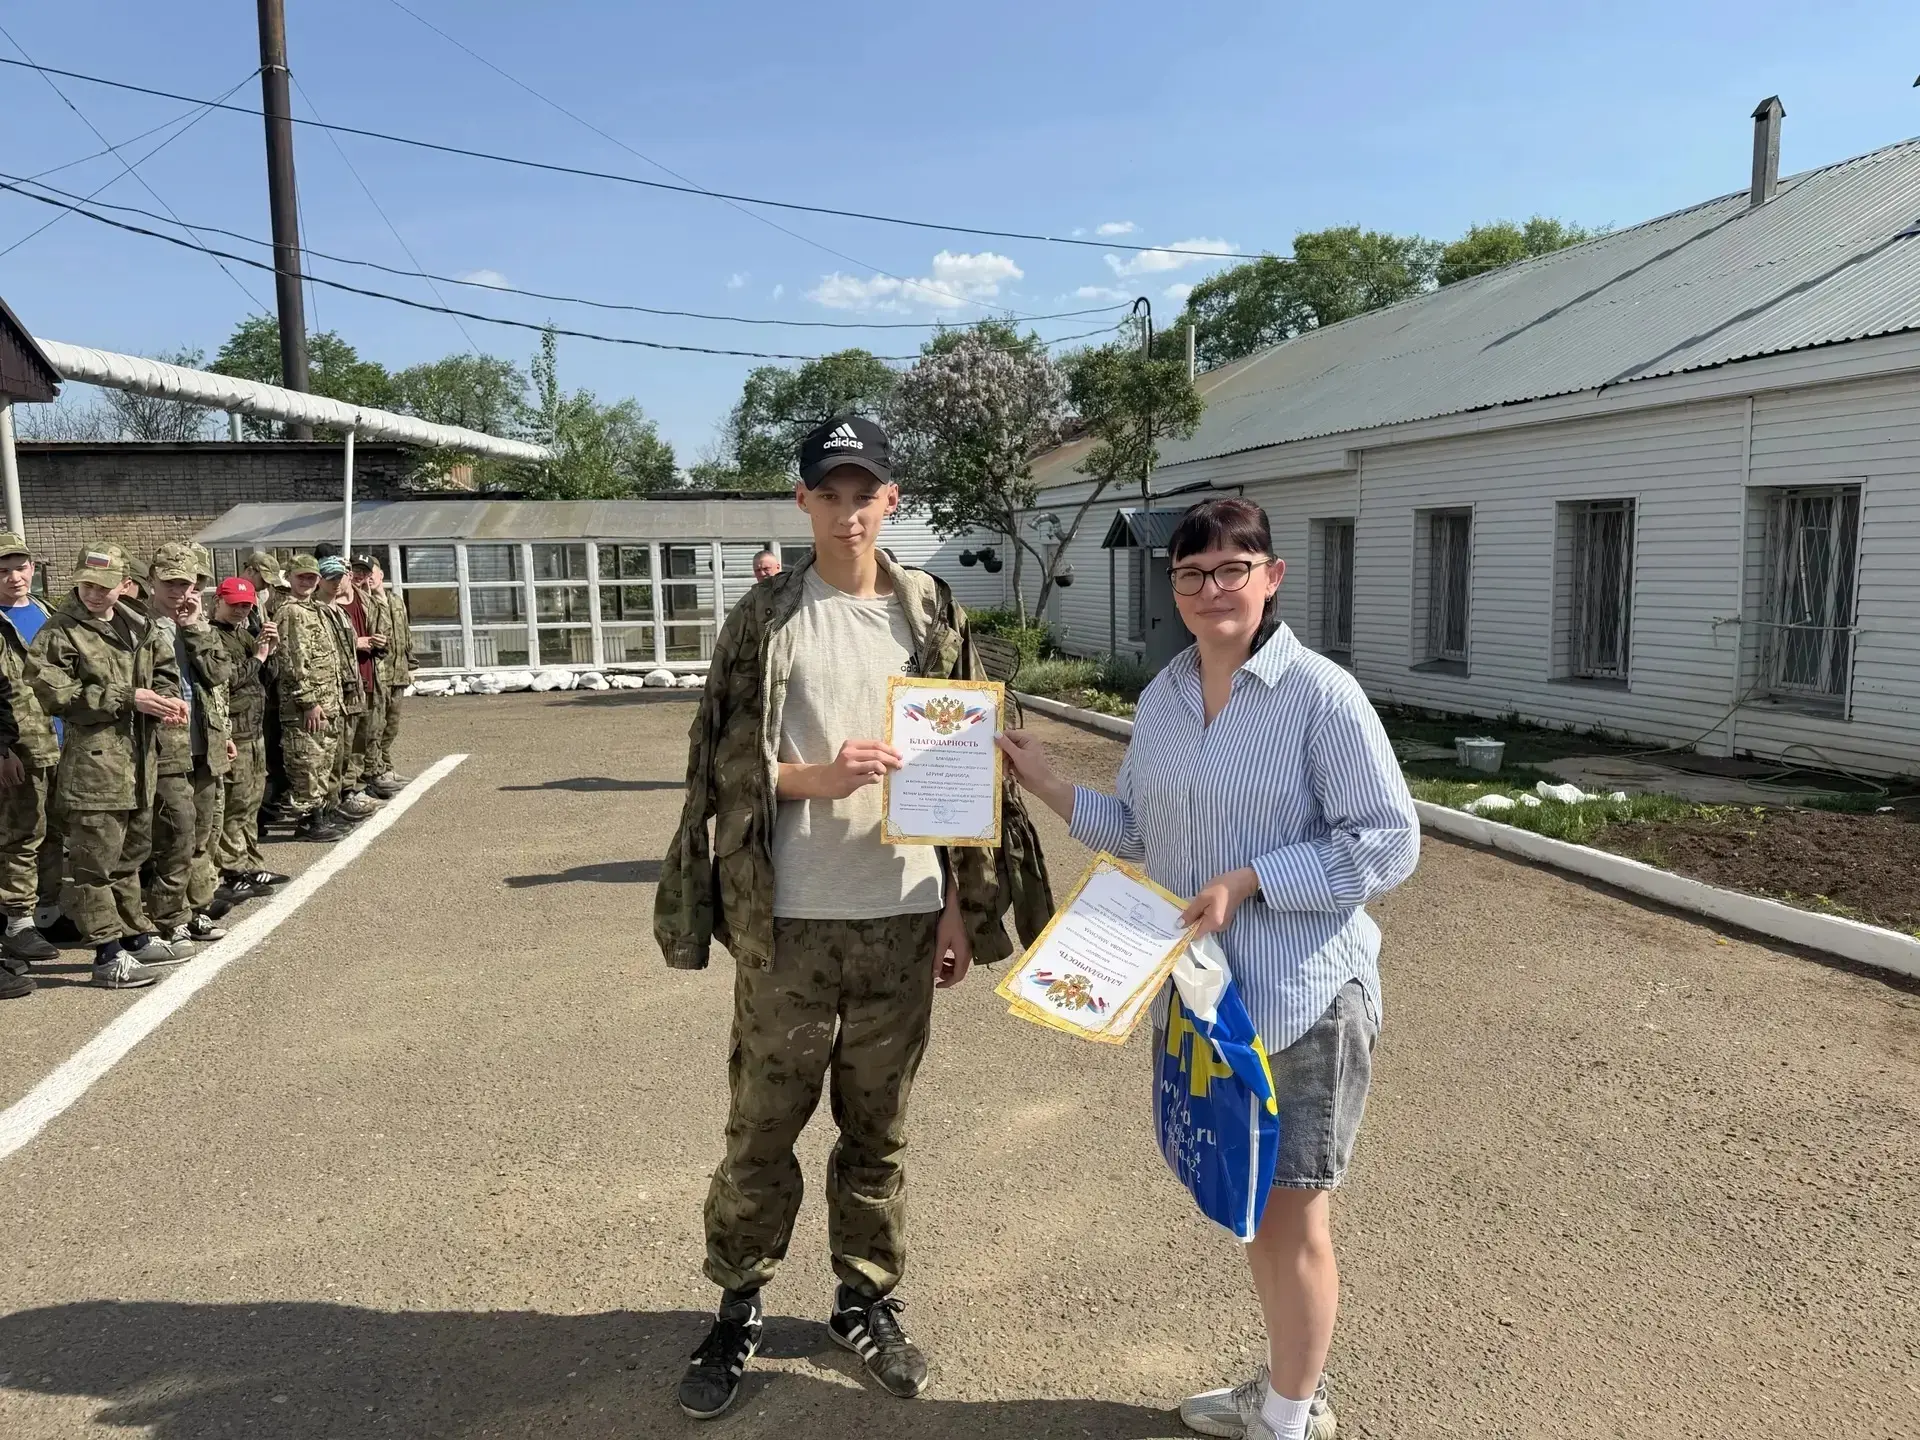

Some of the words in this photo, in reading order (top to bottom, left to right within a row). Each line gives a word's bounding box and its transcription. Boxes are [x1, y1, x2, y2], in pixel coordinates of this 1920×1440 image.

[823, 437, 864, 450] adidas
[909, 738, 979, 748] БЛАГОДАРНОСТЬ
[1059, 950, 1123, 987] БЛАГОДАРНОСТЬ
